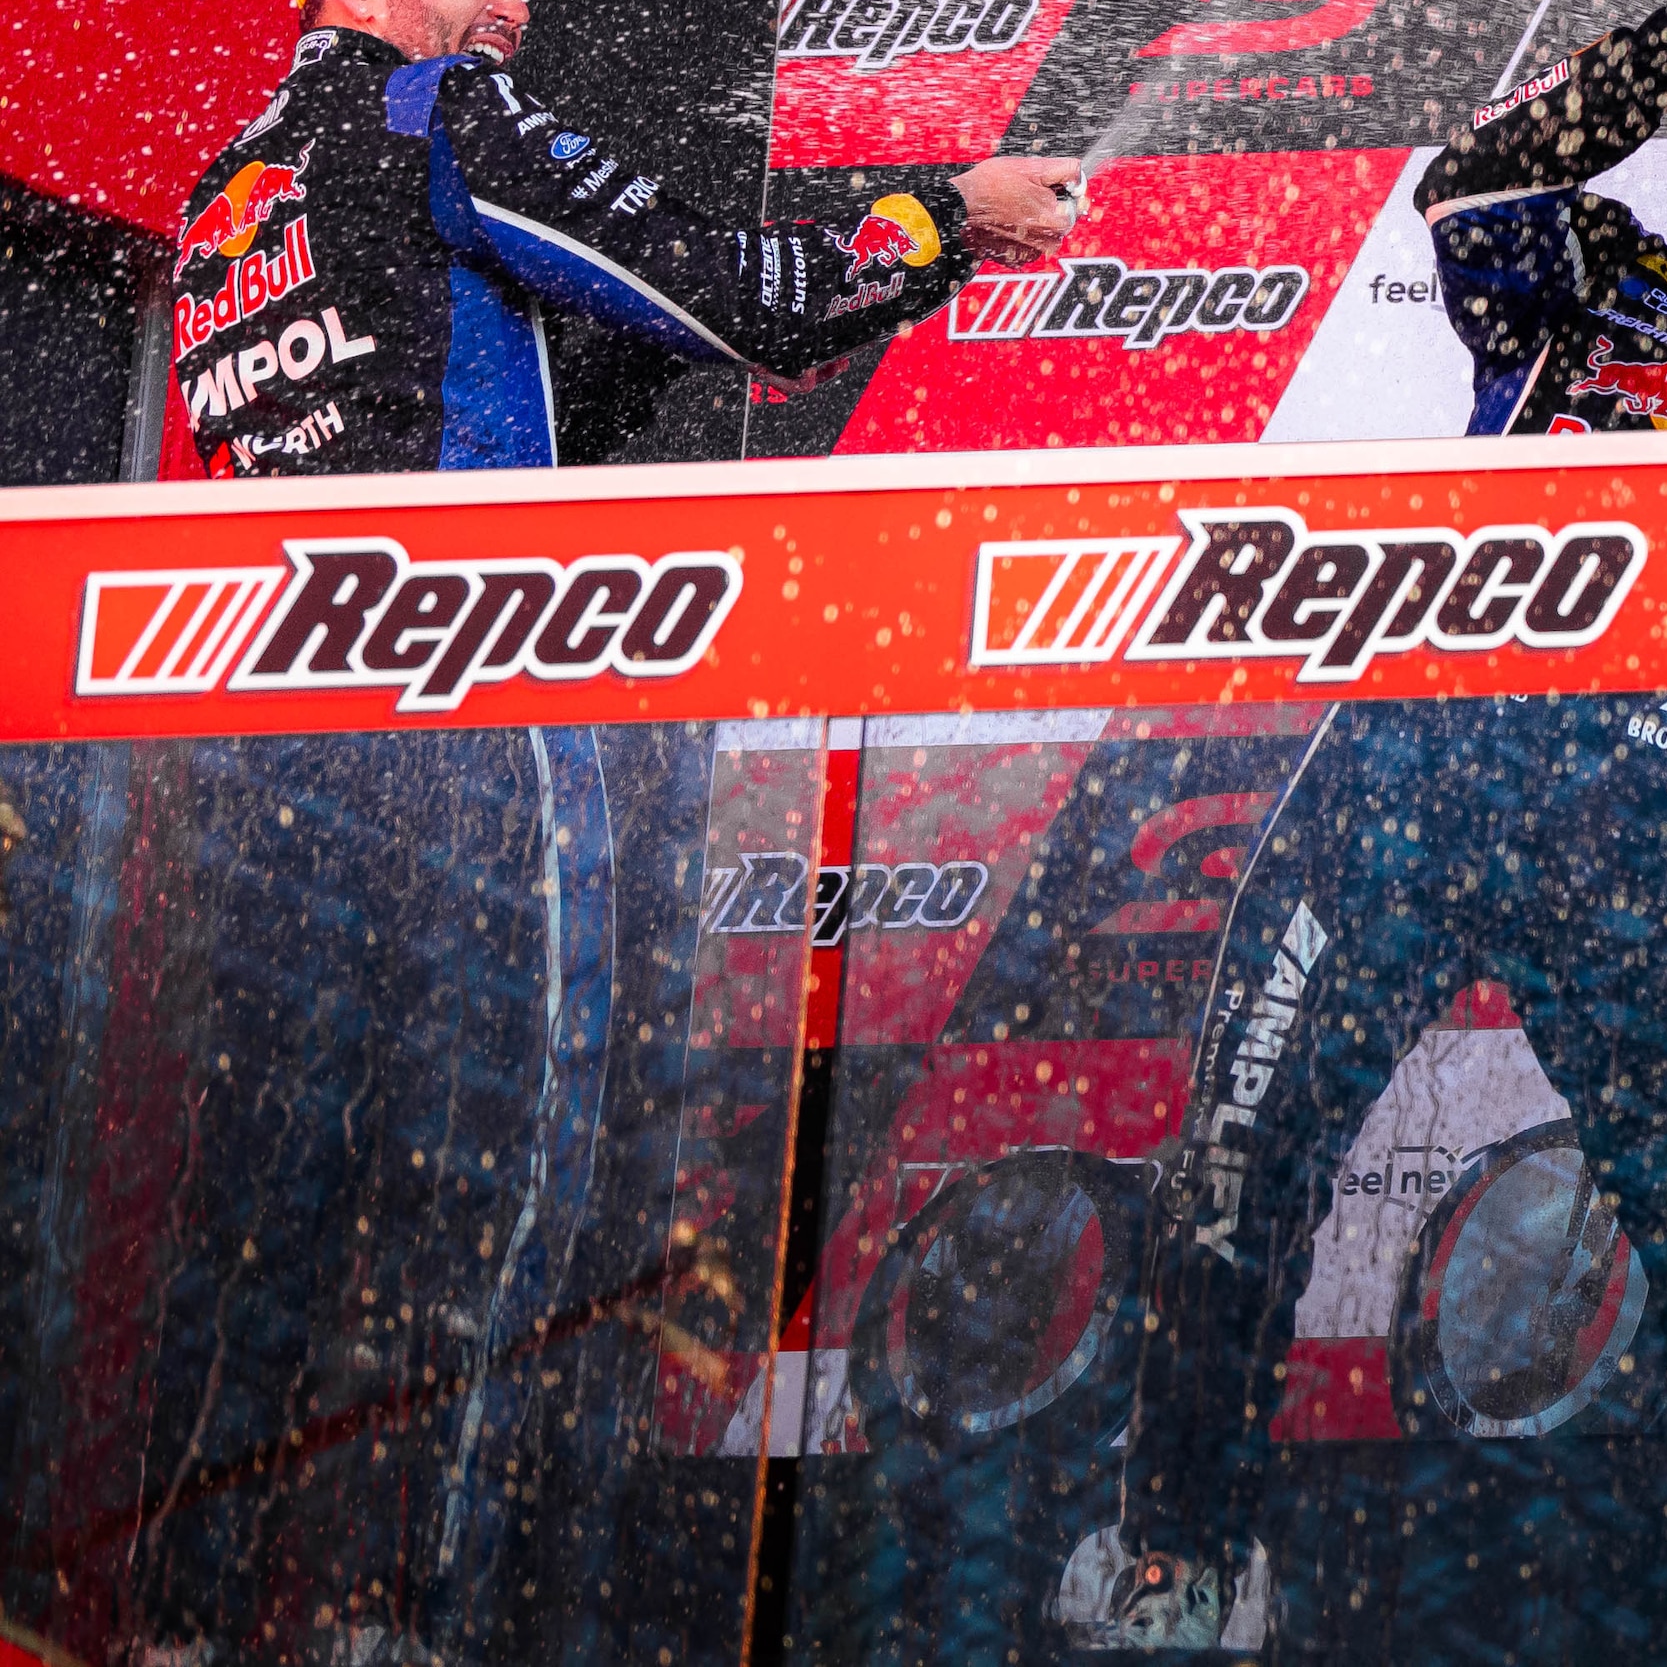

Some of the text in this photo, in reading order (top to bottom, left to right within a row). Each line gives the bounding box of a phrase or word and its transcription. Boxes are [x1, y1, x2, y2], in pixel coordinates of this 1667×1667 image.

[1129, 74, 1375, 103] SUPERCARS
[1473, 58, 1569, 132] Red Bull
[174, 213, 317, 364] Red Bull
[788, 236, 807, 315] Suttons
[823, 272, 906, 322] Red Bull
[1031, 257, 1312, 351] Repco
[1369, 274, 1438, 305] feel
[228, 537, 742, 713] Repco
[1124, 506, 1649, 684] Repco
[715, 851, 989, 947] Repco
[1196, 947, 1308, 1264] AMPLIFY
[1332, 1162, 1457, 1196] eel ne
